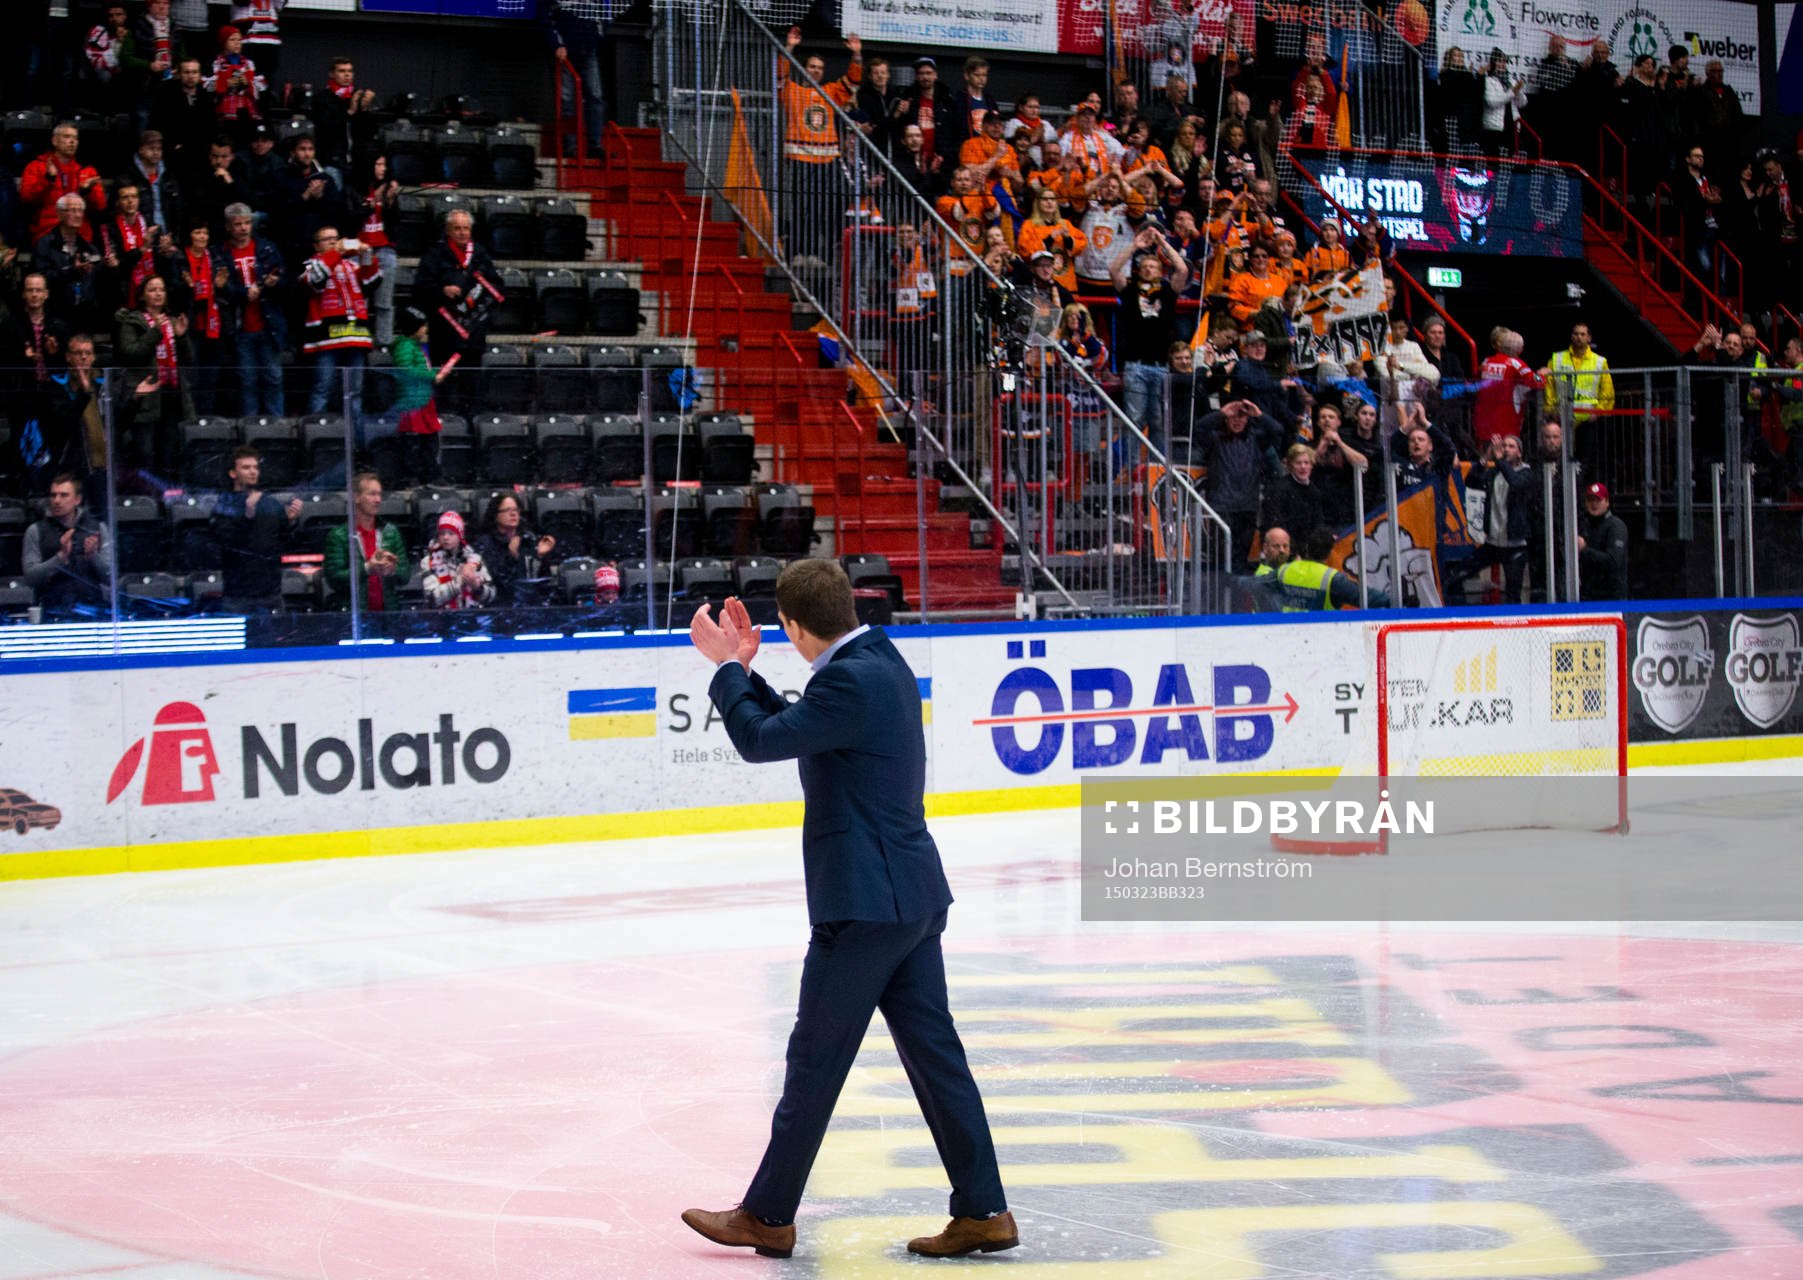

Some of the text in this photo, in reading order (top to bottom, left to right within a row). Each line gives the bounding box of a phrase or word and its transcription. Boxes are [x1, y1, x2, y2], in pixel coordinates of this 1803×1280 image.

[1521, 2, 1600, 31] Flowcrete
[1699, 36, 1757, 61] weber
[1367, 177, 1424, 213] STAD
[1635, 655, 1711, 688] GOLF
[1728, 652, 1802, 683] GOLF
[991, 639, 1274, 775] ÖBAB
[241, 713, 511, 799] Nolato
[672, 749, 709, 763] Hela
